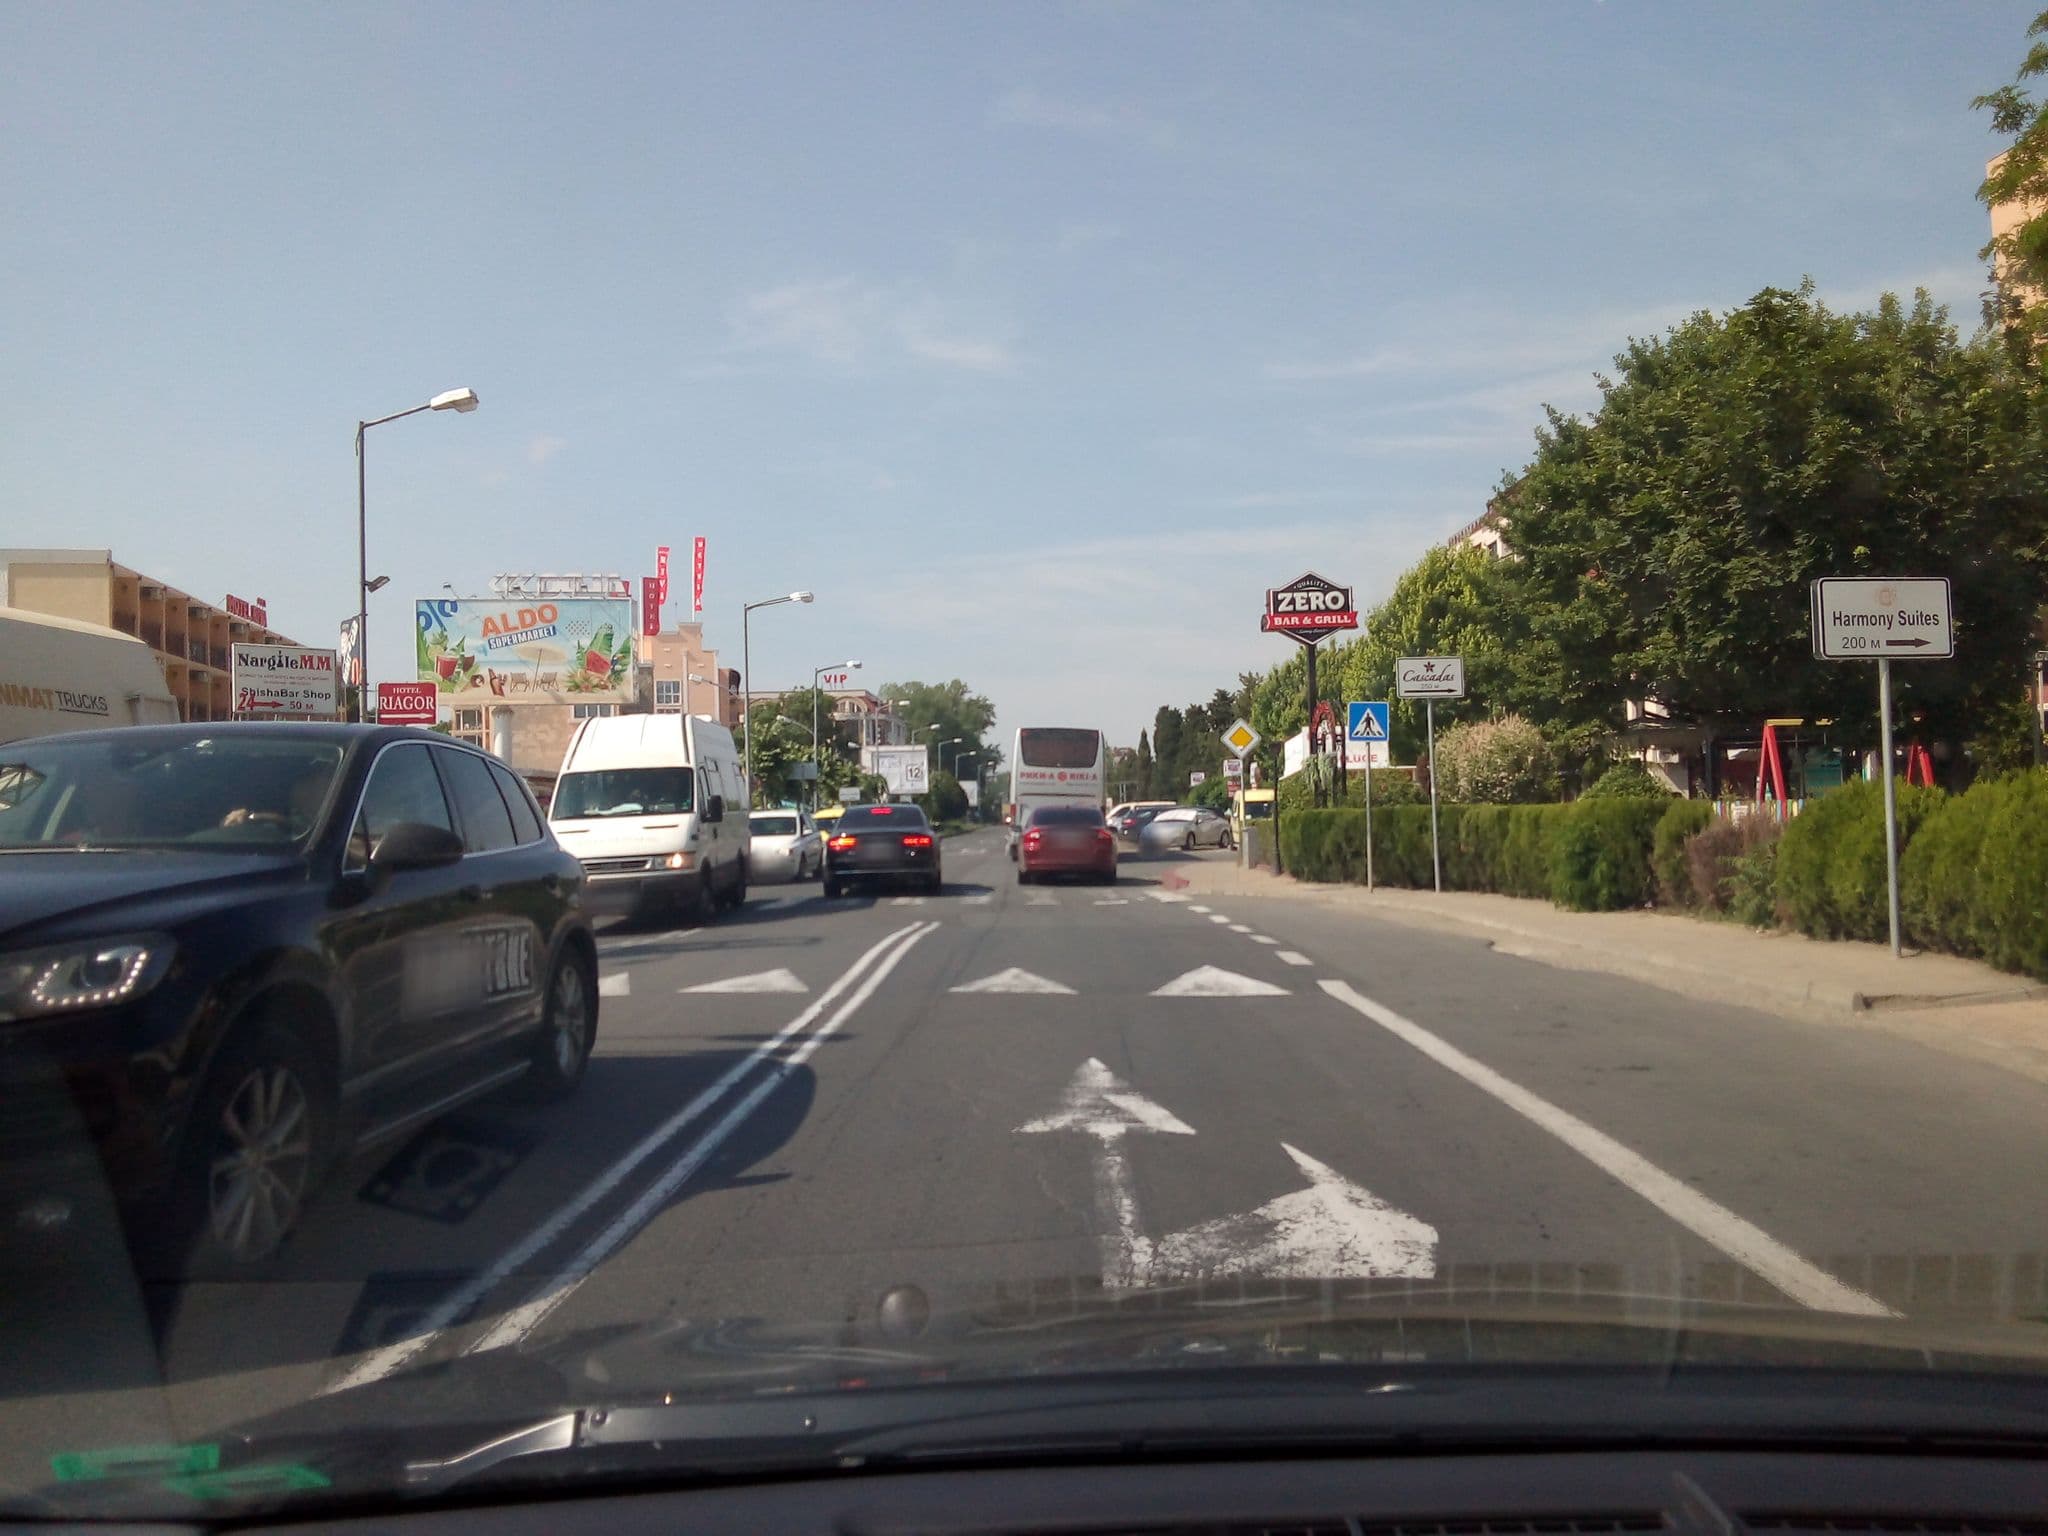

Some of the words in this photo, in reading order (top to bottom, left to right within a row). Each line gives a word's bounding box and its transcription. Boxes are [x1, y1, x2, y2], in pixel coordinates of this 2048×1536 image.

[1278, 591, 1345, 612] ZERO
[482, 603, 559, 638] ALDO
[1274, 616, 1300, 626] BAR
[1302, 616, 1312, 625] &
[1314, 614, 1352, 625] GRILL
[1832, 610, 1894, 630] Harmony
[1898, 610, 1940, 626] Suites
[489, 625, 556, 649] SUPERMARKET
[1842, 636, 1866, 649] 200
[823, 674, 848, 684] VIP
[1403, 664, 1456, 682] Cascadas
[55, 690, 109, 712] TRUCKS
[303, 690, 332, 701] Shop
[380, 695, 435, 710] RIAGOR
[289, 700, 302, 710] 50
